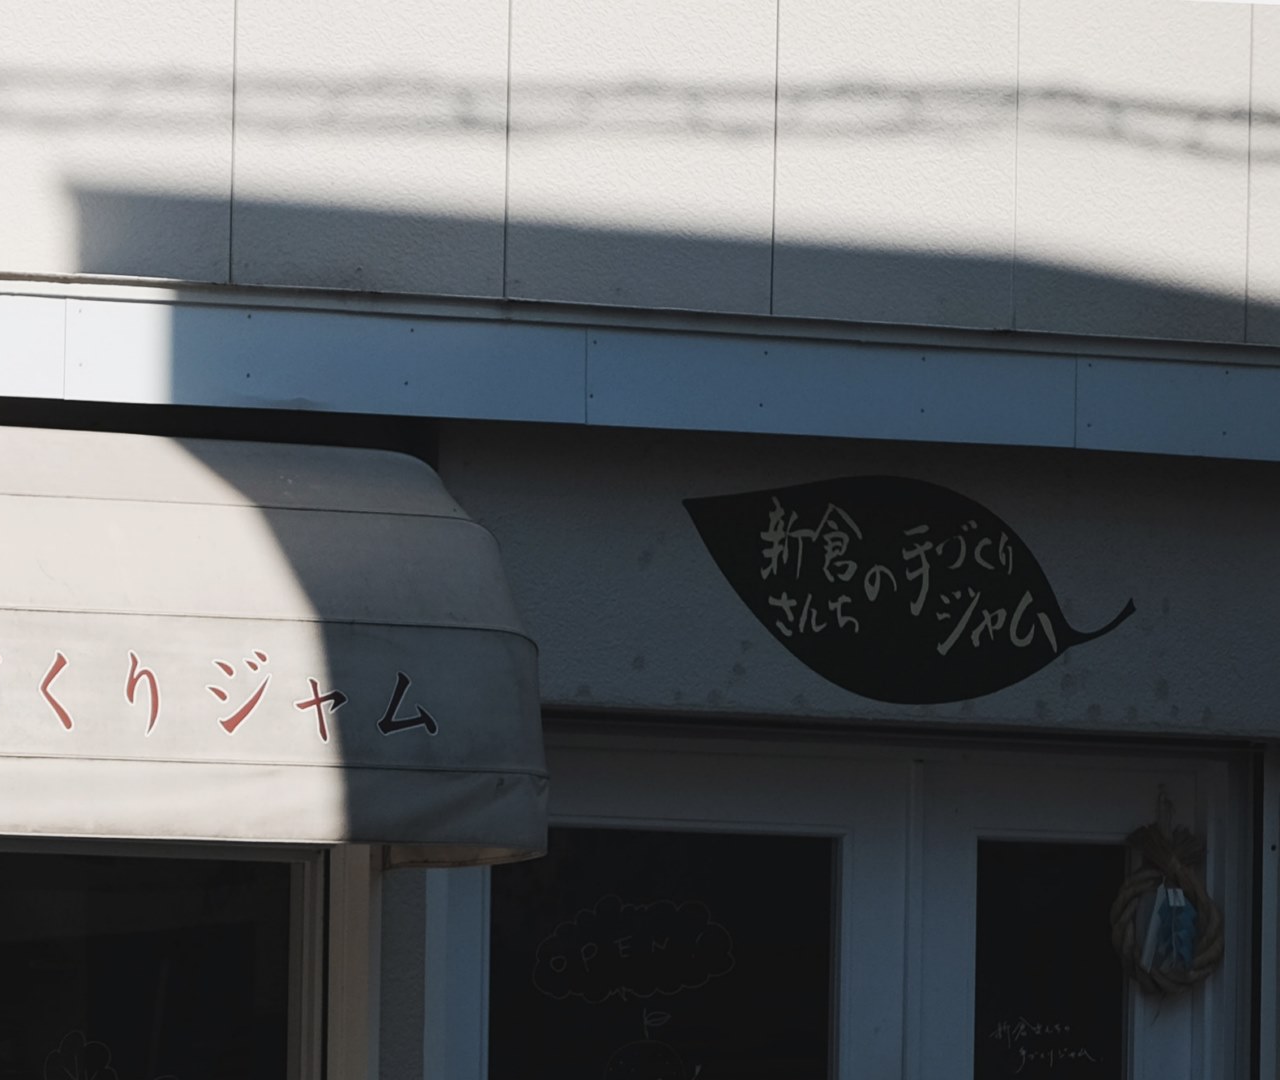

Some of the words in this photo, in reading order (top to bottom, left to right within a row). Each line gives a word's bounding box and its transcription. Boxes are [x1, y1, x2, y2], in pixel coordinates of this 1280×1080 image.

[760, 496, 863, 582] 新倉
[902, 520, 1015, 617] 手づくり
[767, 591, 860, 638] さんち
[935, 586, 1059, 656] ジャム
